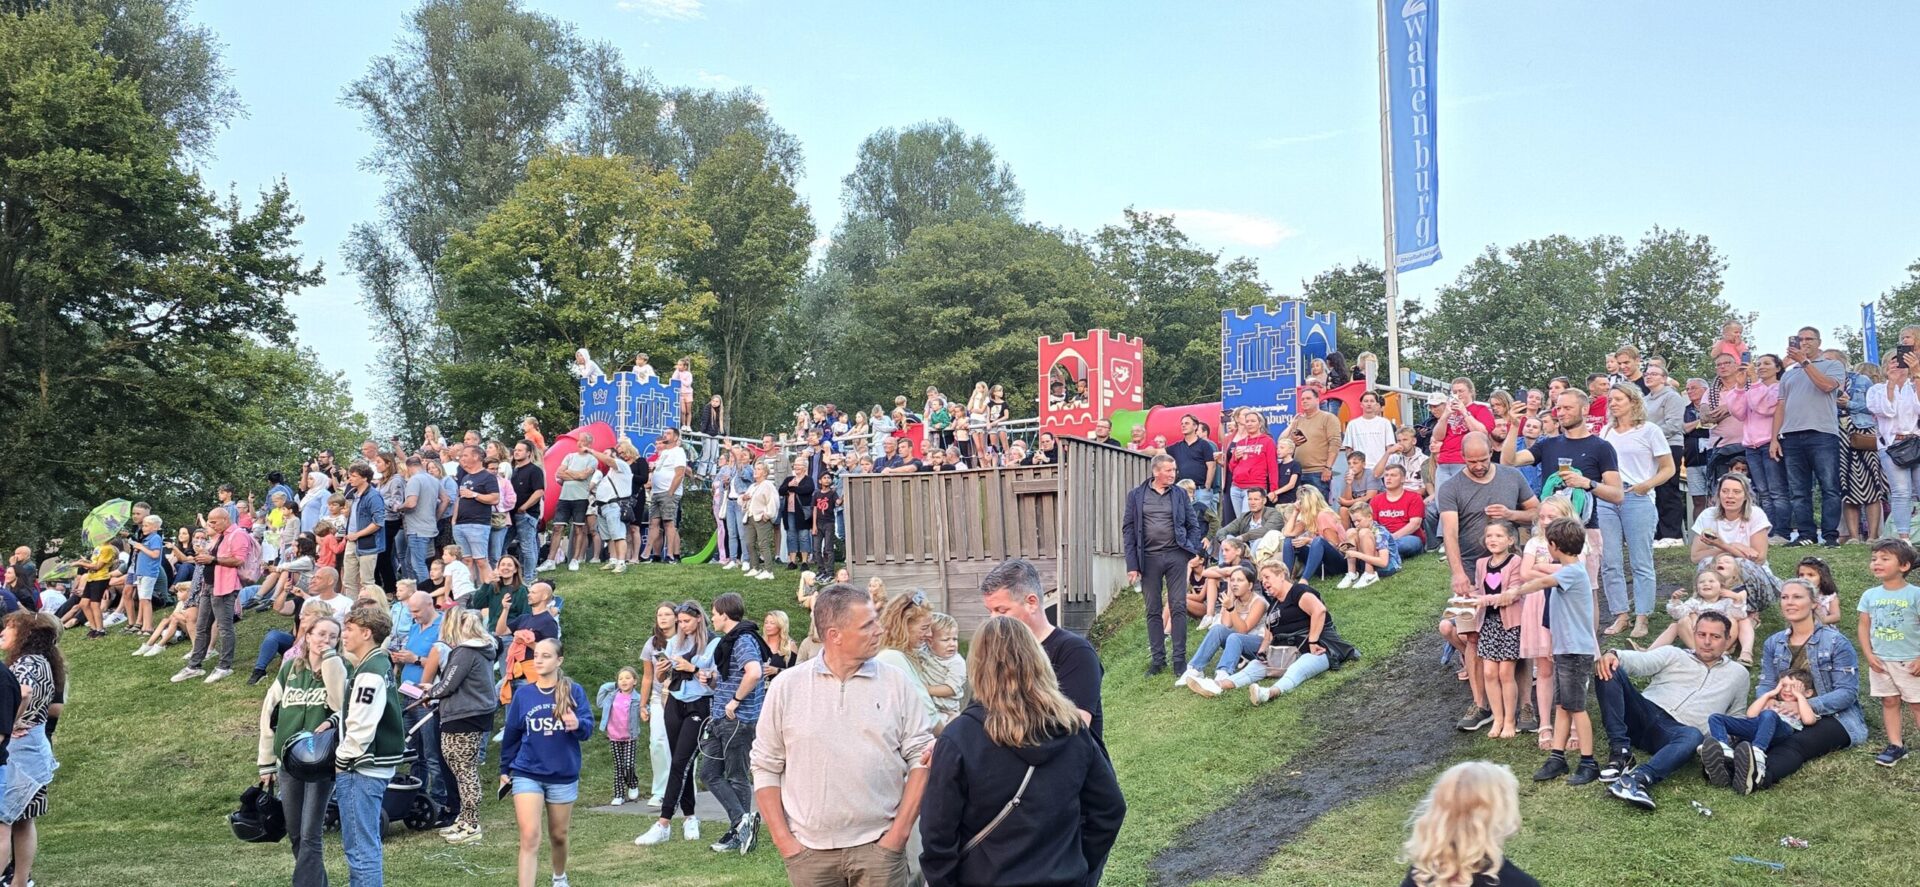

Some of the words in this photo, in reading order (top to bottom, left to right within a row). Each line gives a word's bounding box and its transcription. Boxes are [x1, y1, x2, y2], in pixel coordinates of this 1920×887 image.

[1379, 509, 1404, 517] adidas
[355, 687, 376, 705] 15
[530, 717, 564, 731] USA
